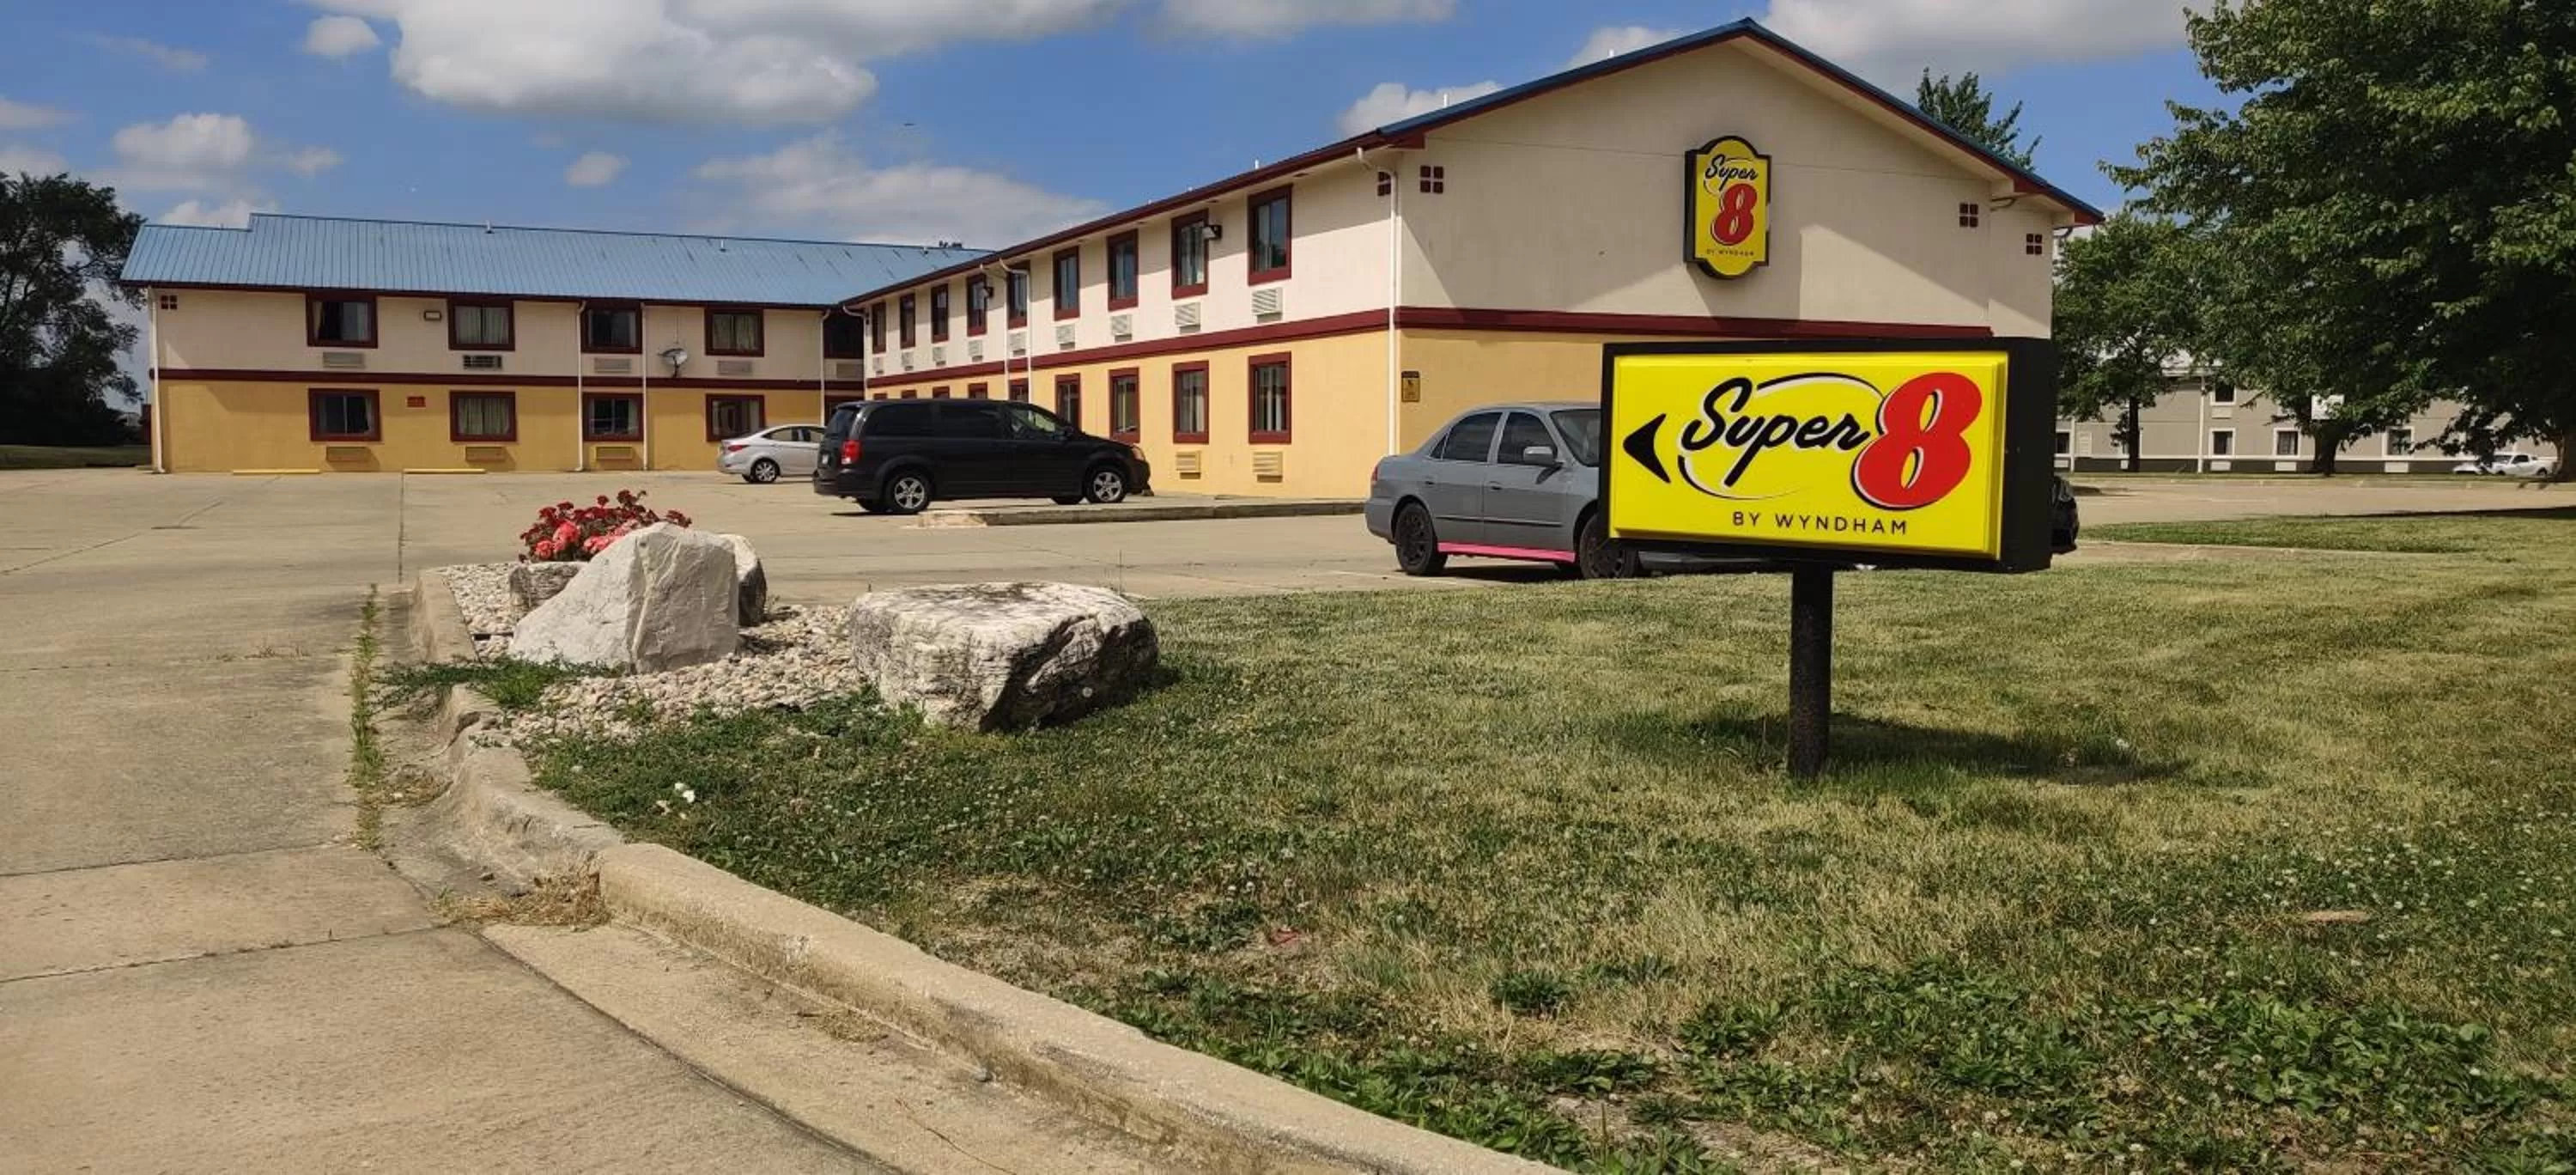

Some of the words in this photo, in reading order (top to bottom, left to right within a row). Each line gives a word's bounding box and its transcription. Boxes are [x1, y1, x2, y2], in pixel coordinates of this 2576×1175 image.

[1705, 154, 1759, 192] Super
[1710, 183, 1758, 247] 8
[1680, 376, 1871, 488] Super
[1850, 371, 1983, 511] 8
[1733, 511, 1760, 527] BY
[1775, 513, 1906, 534] WYNDHAM
